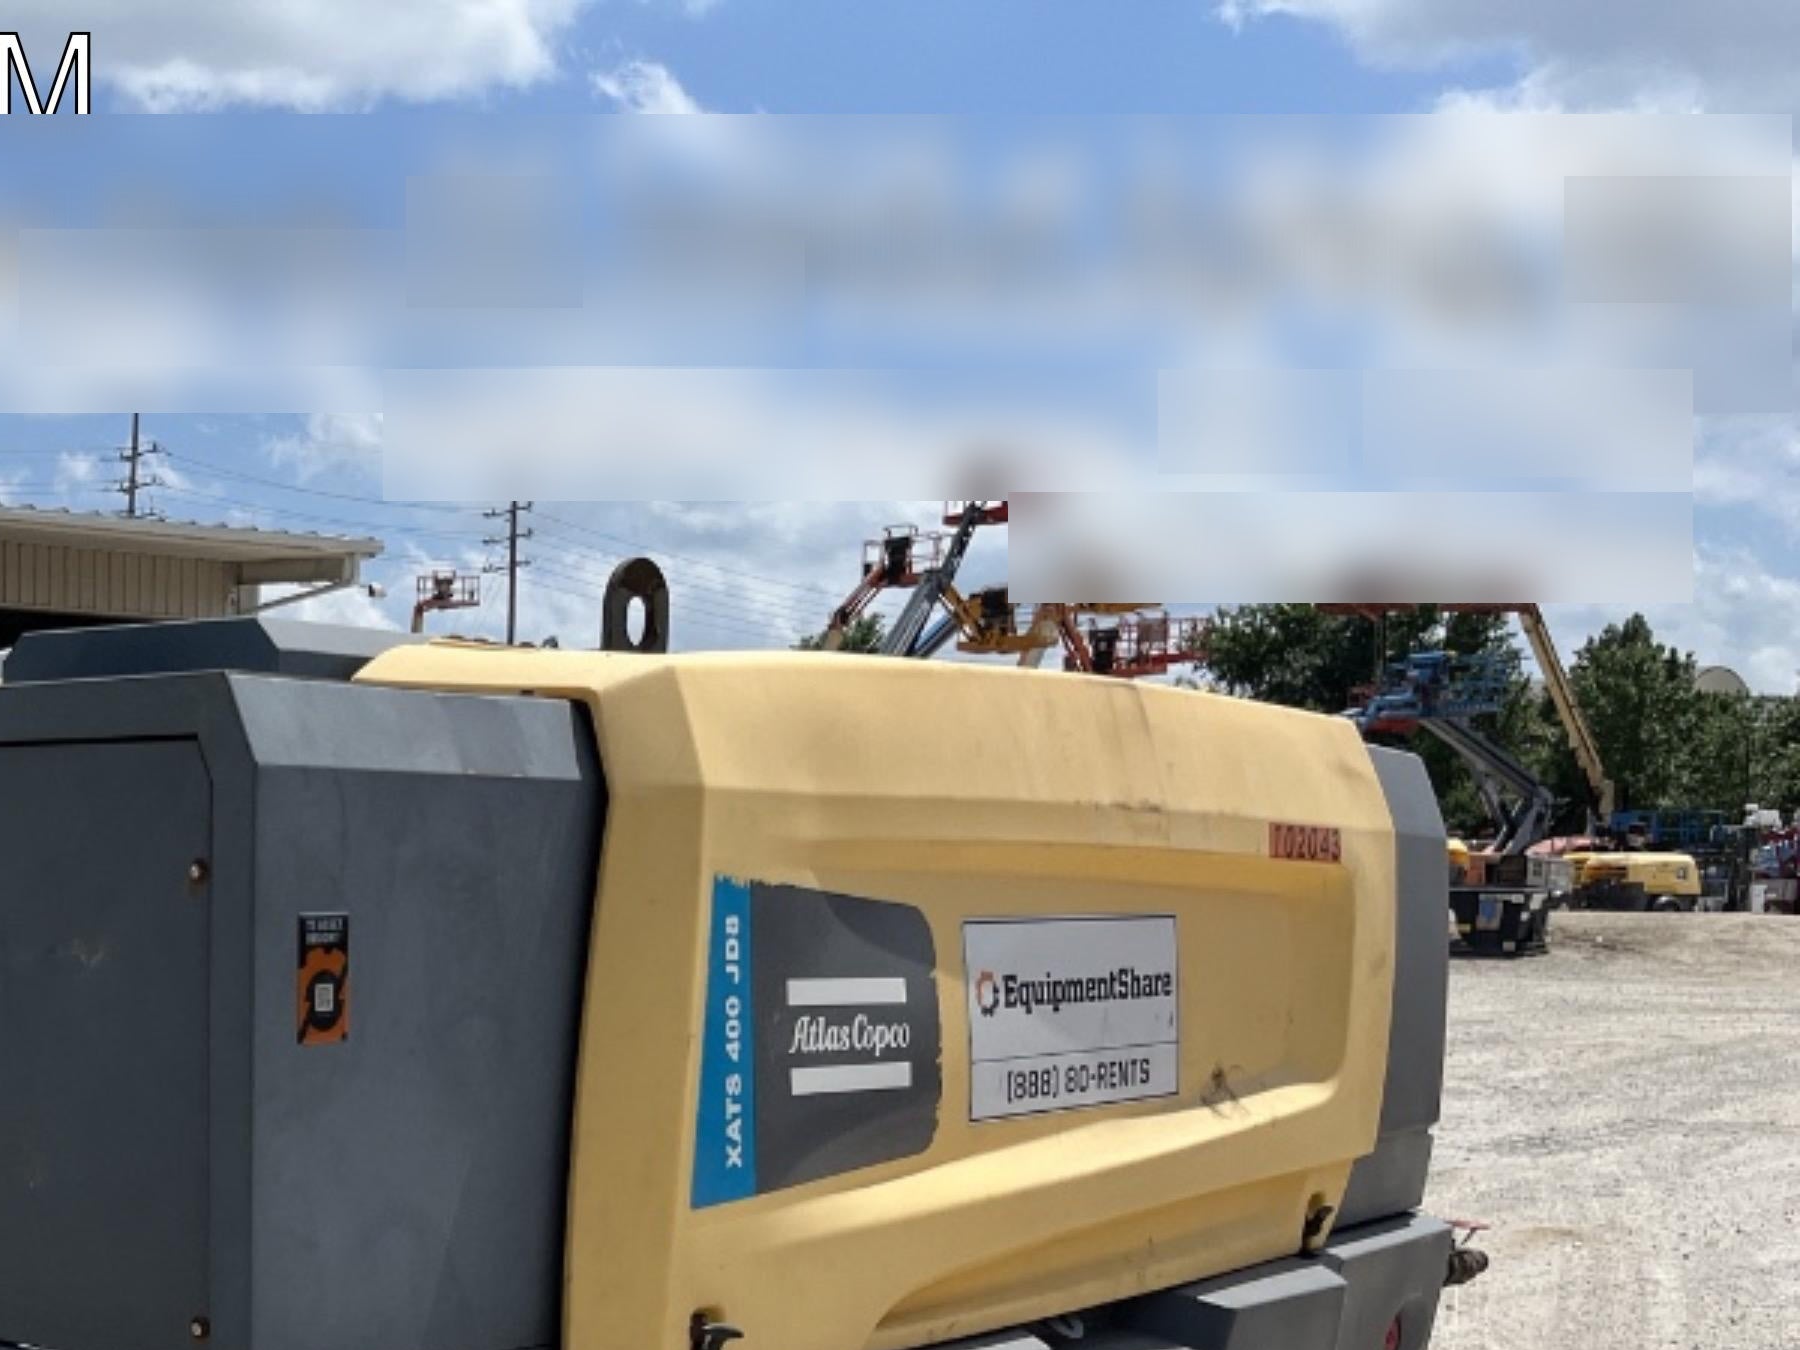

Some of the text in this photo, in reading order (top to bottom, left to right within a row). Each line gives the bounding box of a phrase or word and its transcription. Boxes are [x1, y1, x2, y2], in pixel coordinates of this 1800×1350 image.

[1273, 824, 1340, 861] 102043
[1003, 968, 1172, 1014] EquipmentShare
[725, 996, 741, 1061] 400
[788, 1013, 910, 1057] Atlas Copco
[1007, 1058, 1150, 1104] (888) 80-RENTS
[725, 1073, 742, 1168] XATS
